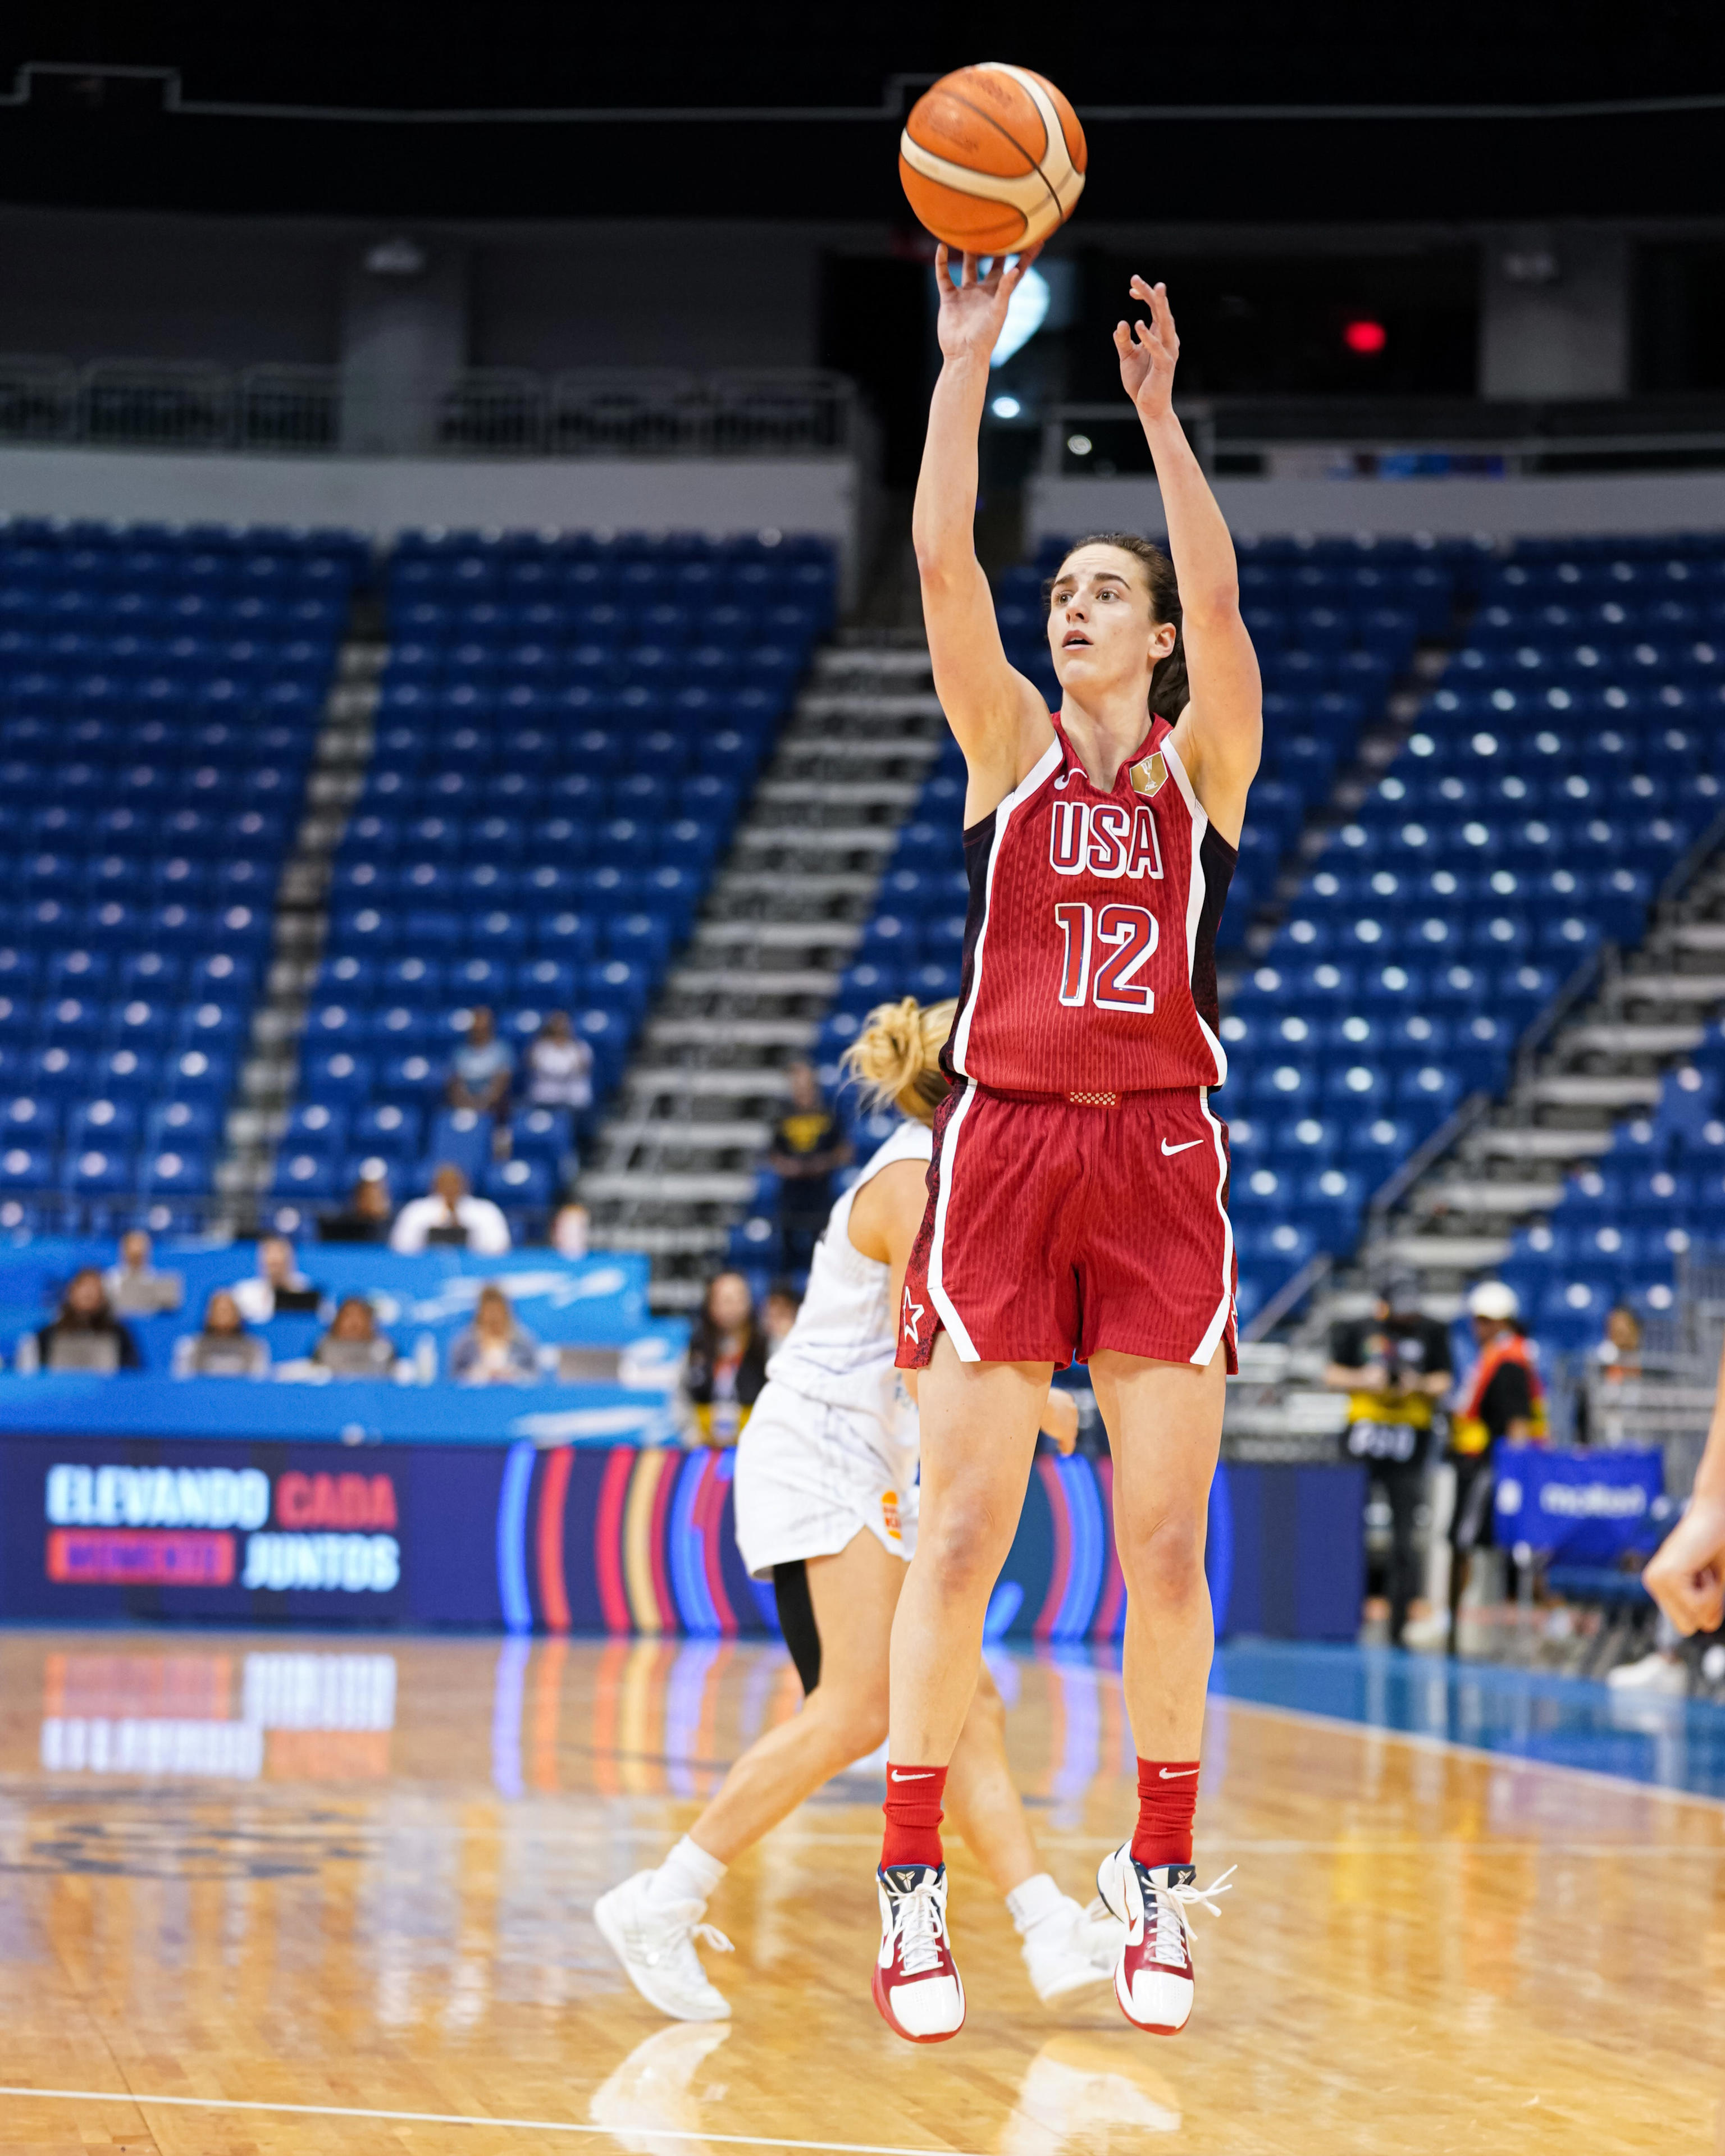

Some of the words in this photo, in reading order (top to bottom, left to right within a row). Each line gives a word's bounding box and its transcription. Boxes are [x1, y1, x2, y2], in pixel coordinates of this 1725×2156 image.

[1049, 801, 1164, 879] USA
[1055, 903, 1159, 1014] 12
[47, 1464, 270, 1529] ELEVANDO
[277, 1473, 397, 1530] CADA
[243, 1532, 400, 1592] JUNTOS
